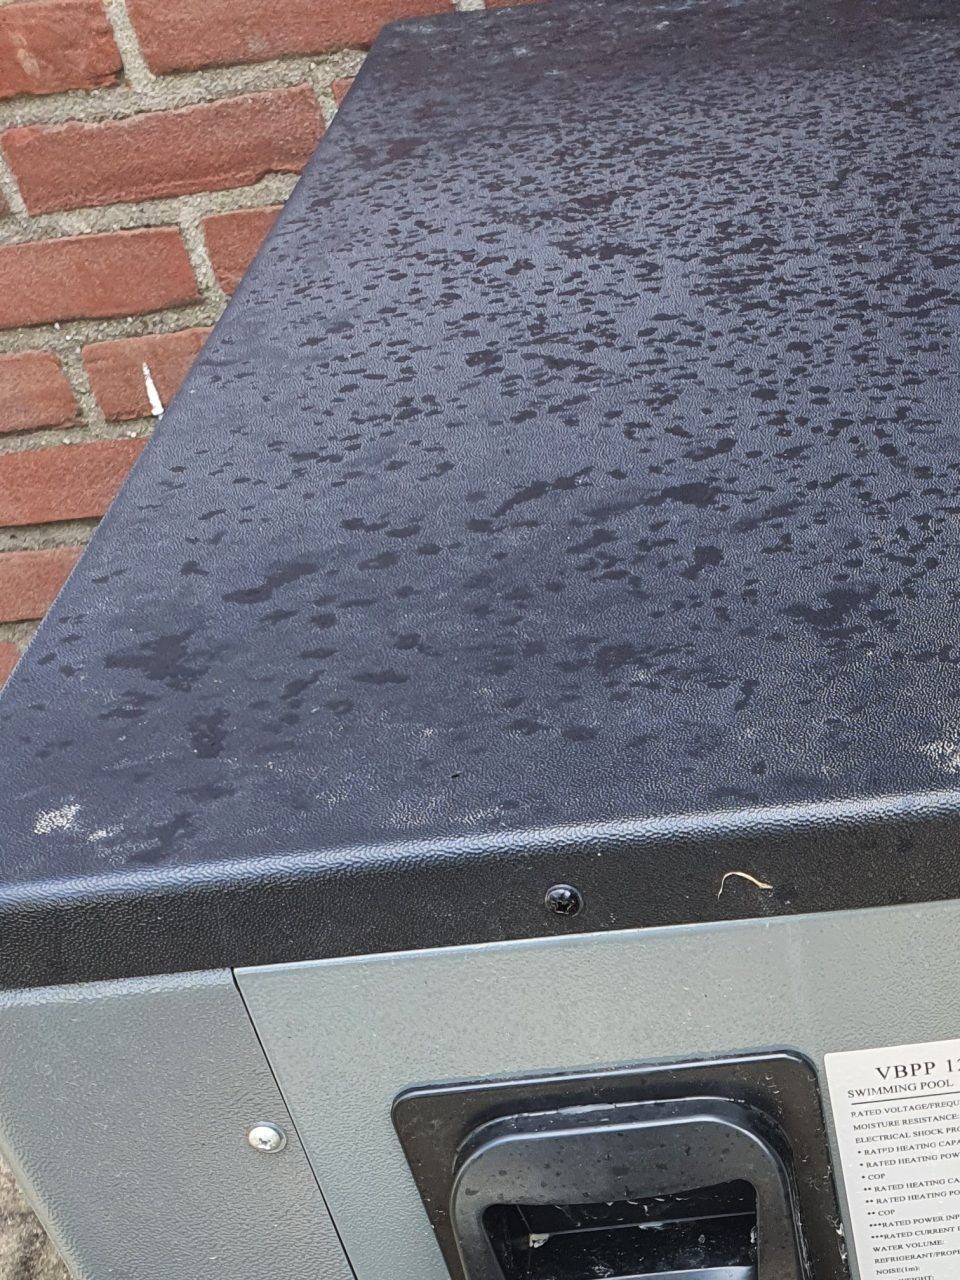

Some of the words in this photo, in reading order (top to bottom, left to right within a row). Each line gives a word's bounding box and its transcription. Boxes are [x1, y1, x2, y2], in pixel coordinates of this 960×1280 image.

[875, 1062, 936, 1080] VBPP
[847, 1083, 917, 1098] SWIMMING
[920, 1079, 954, 1090] POOL
[851, 1109, 882, 1118] RATED
[853, 1120, 900, 1131] MOISTURE
[902, 1113, 959, 1125] RESISTANCE:
[855, 1132, 911, 1144] ELECTRICAL
[912, 1128, 944, 1137] SHOCK
[896, 1142, 936, 1152] HEATING
[866, 1159, 896, 1168] RATED
[898, 1155, 938, 1165] HEATING
[868, 1173, 886, 1181] COP
[874, 1184, 904, 1192] RATED
[906, 1179, 945, 1189] HEATING
[876, 1196, 906, 1204] RATED
[908, 1191, 947, 1201] HEATING
[913, 1216, 944, 1225] POWER
[914, 1226, 955, 1237] CURRENT
[872, 1244, 903, 1253] WATER
[905, 1239, 944, 1249] VOLUME:
